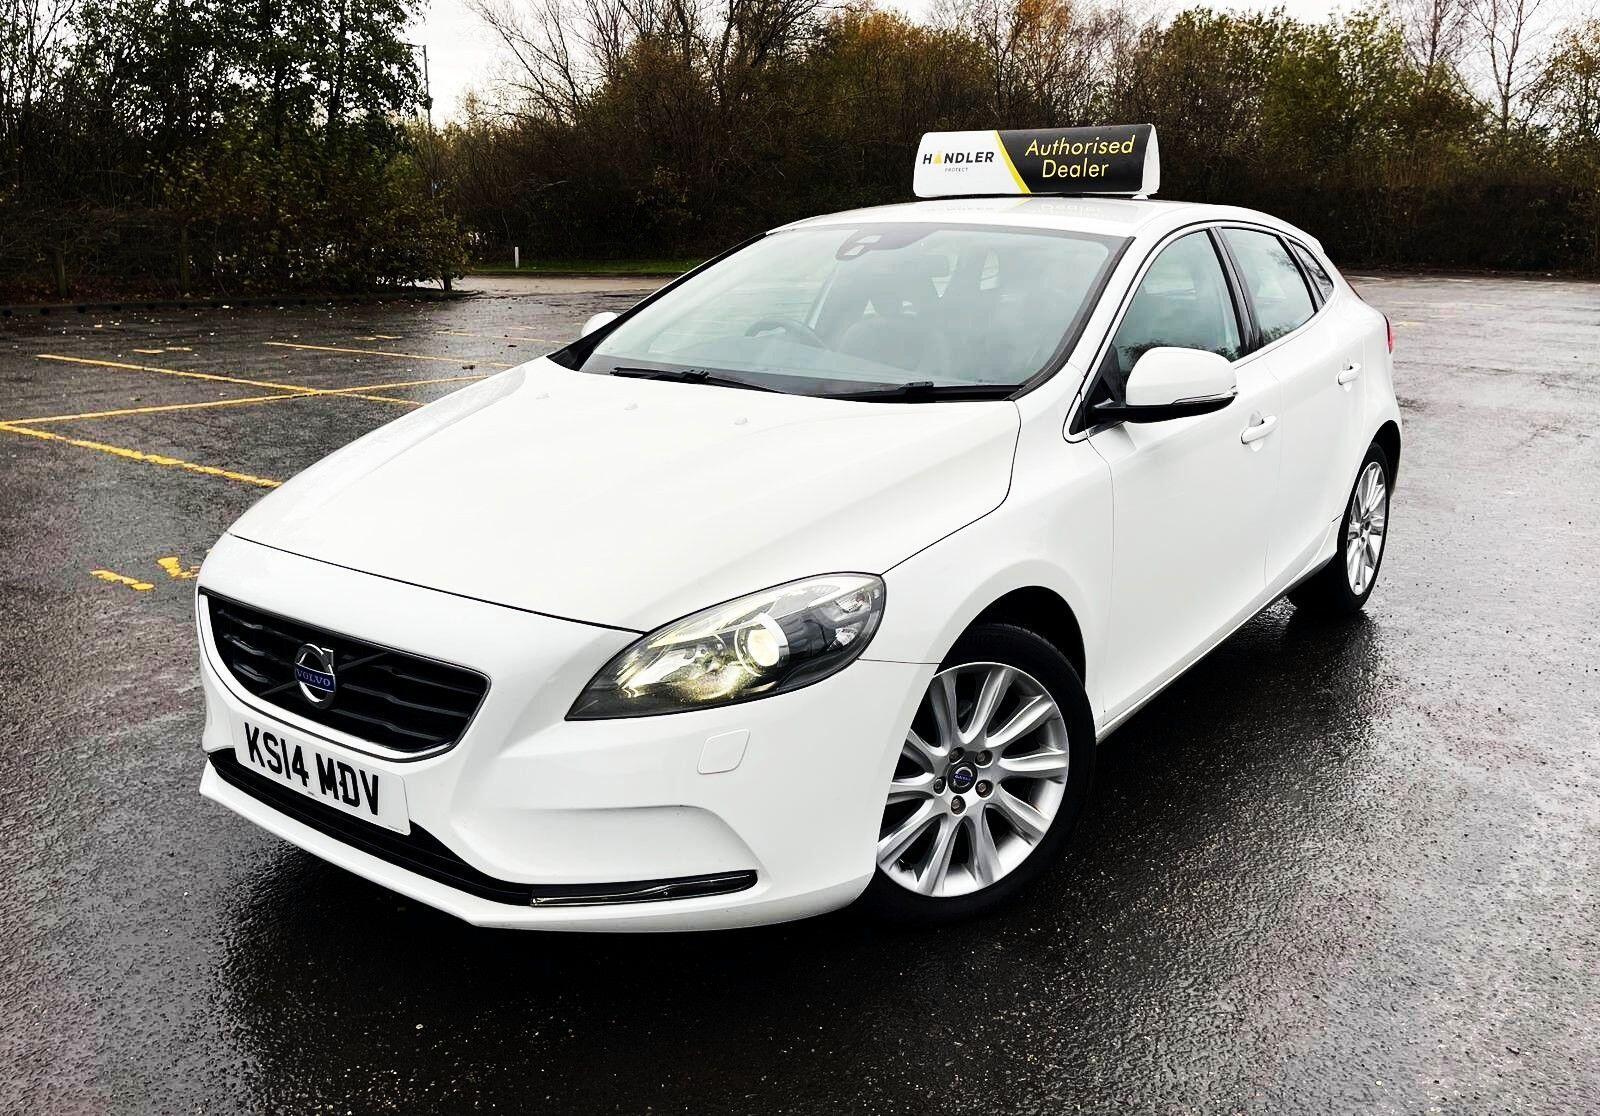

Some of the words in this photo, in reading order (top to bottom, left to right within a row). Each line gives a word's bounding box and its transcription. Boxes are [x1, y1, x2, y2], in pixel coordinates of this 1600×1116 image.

[1025, 134, 1136, 157] Authorised
[1042, 159, 1110, 178] Dealer
[296, 668, 331, 687] VOLVO
[244, 722, 310, 788] KS14
[315, 752, 379, 816] MDV
